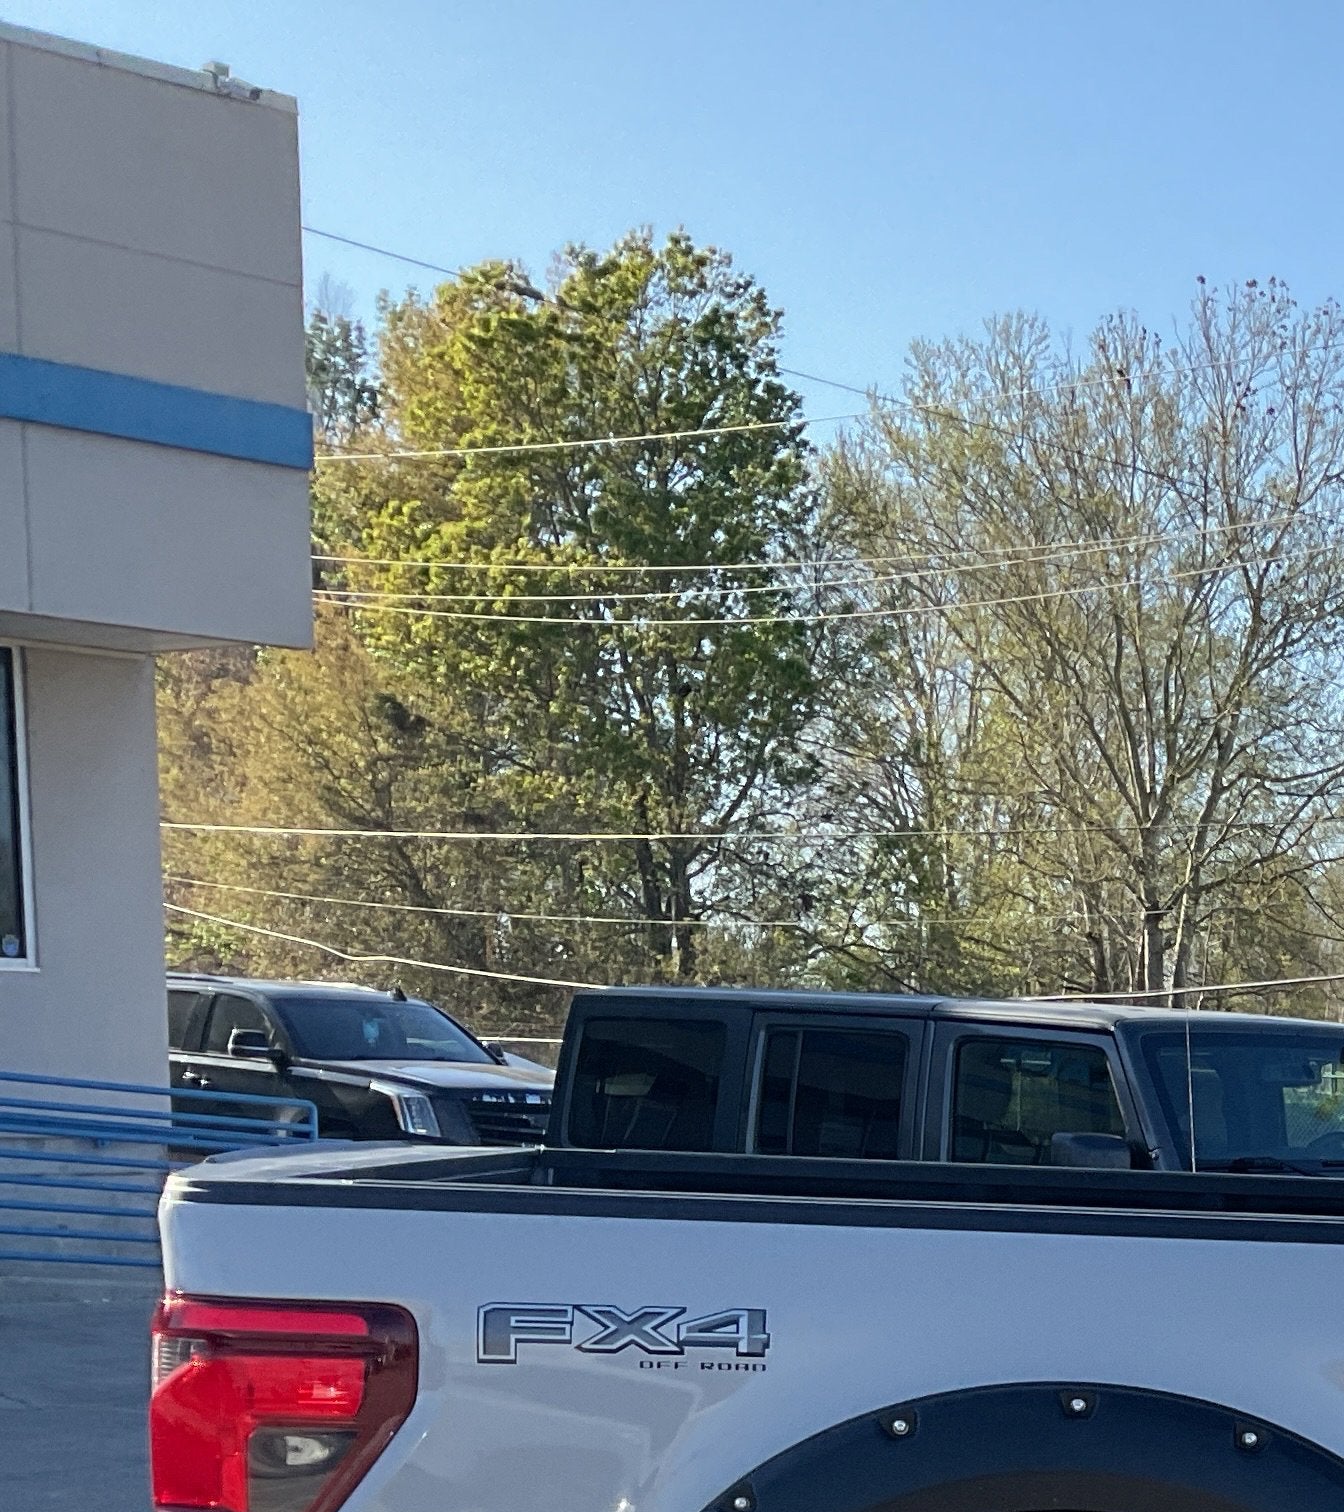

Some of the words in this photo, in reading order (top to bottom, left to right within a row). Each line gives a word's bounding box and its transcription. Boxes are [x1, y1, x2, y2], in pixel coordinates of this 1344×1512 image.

[477, 1302, 771, 1364] FX4
[639, 1360, 688, 1370] OFF
[700, 1361, 767, 1372] ROAD
